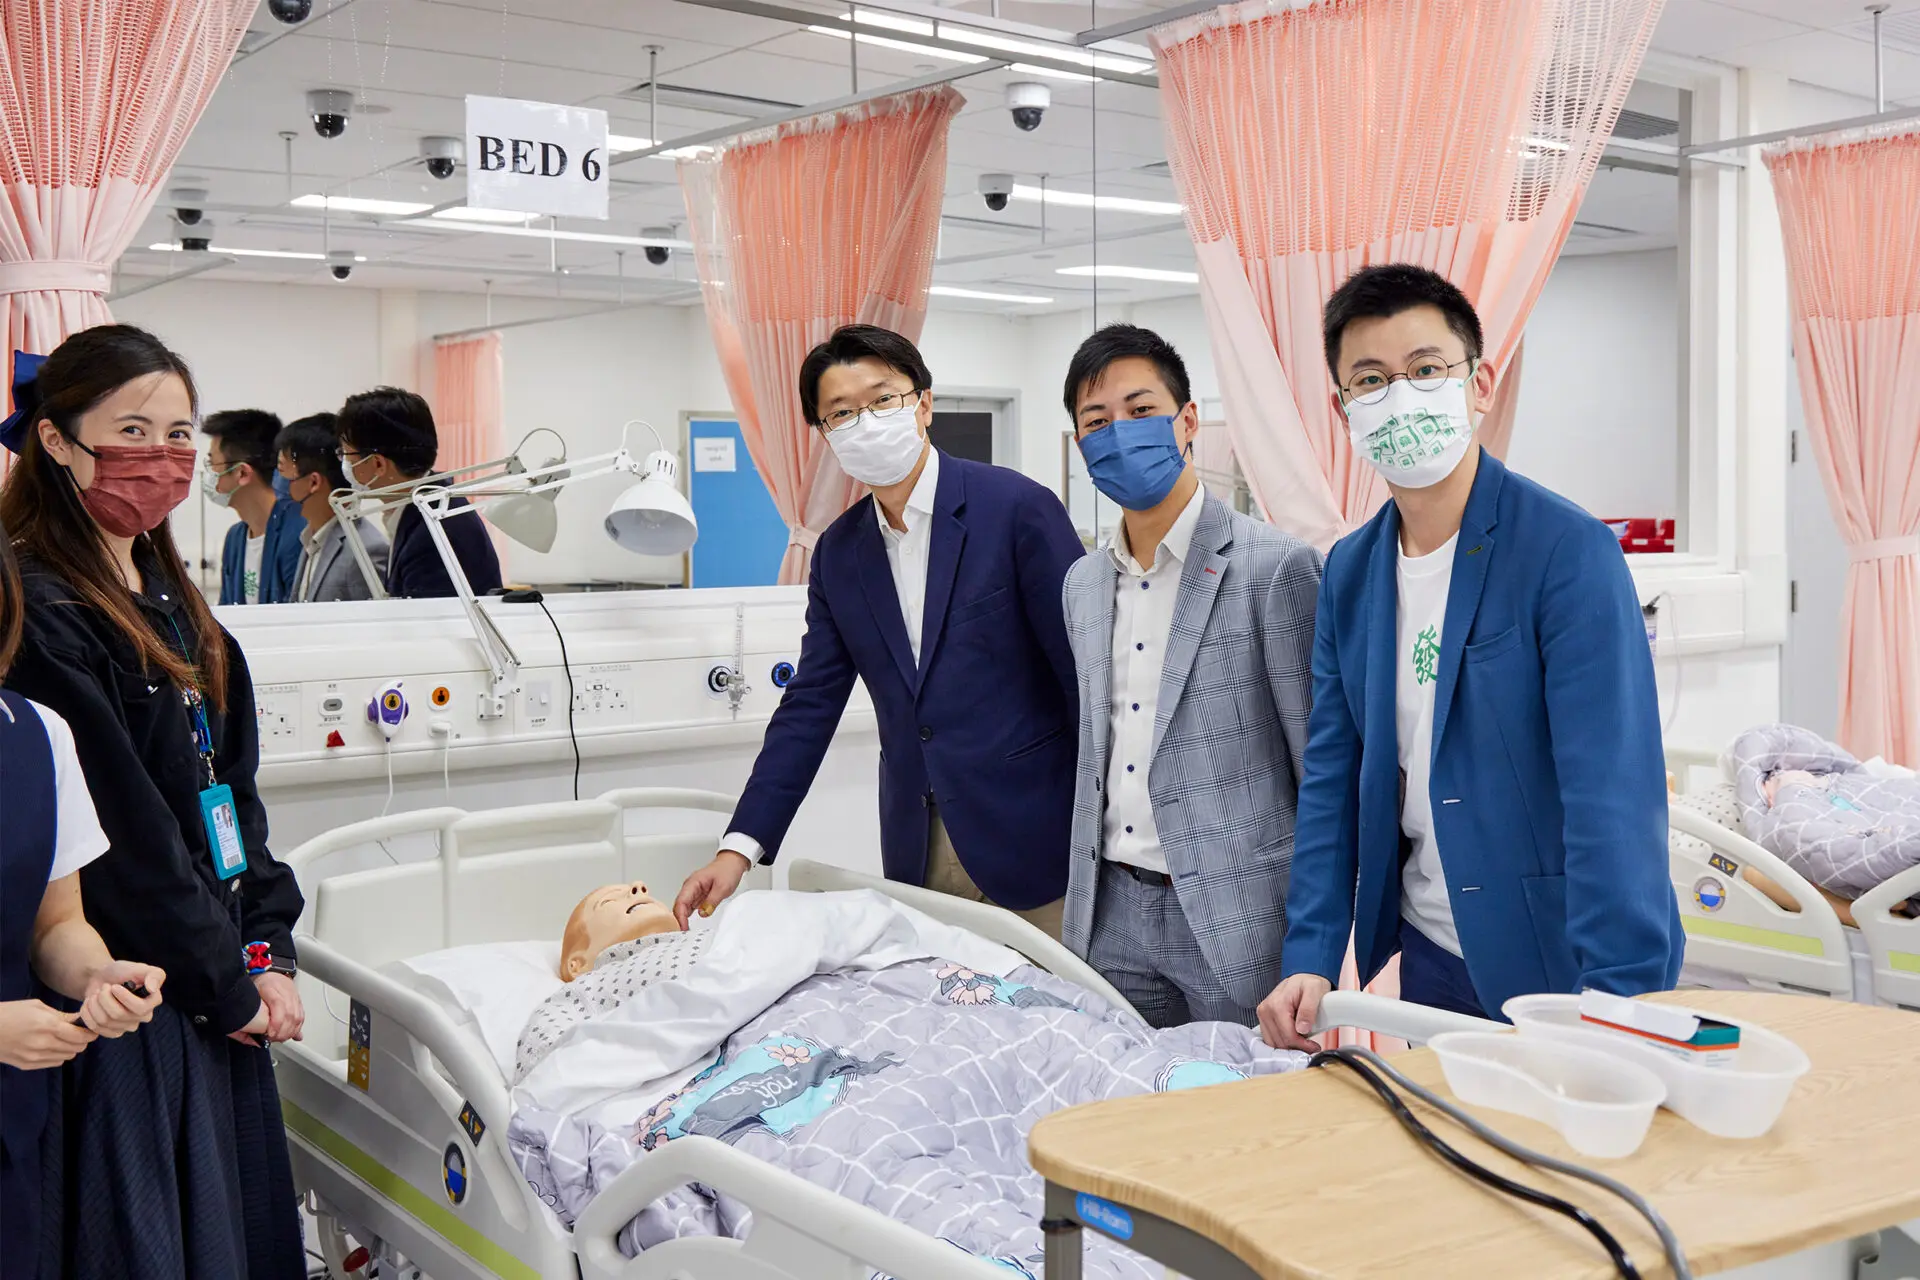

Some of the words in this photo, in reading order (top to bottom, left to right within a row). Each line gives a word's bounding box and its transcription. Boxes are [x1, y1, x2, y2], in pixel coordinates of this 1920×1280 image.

[476, 135, 568, 177] BED
[582, 147, 601, 182] 6
[754, 1075, 799, 1108] you
